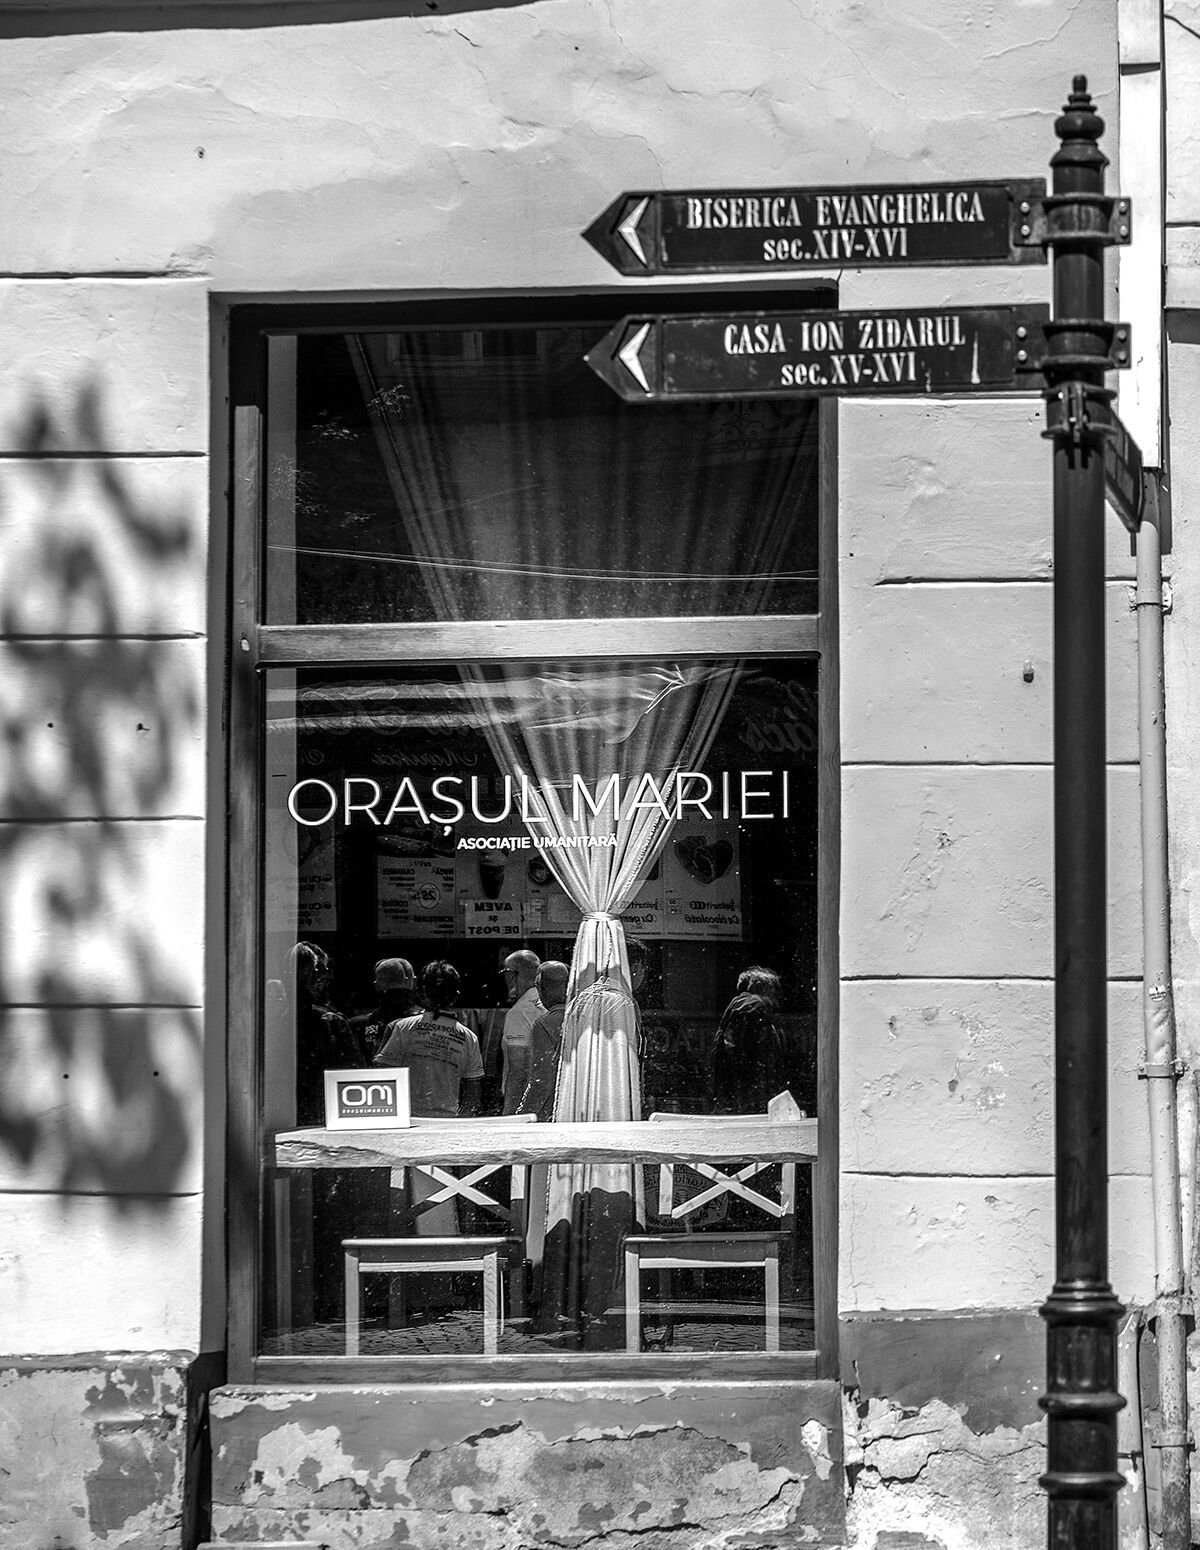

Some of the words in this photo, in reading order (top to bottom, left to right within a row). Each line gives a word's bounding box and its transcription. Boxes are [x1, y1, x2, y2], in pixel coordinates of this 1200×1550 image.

[686, 196, 803, 229] BISERICA
[815, 191, 985, 225] EVANGHELICA
[763, 227, 908, 261] sec.XIV-XVI
[723, 322, 787, 355] CASA
[801, 320, 845, 353] ION
[858, 315, 966, 349] ZIDARUL
[780, 351, 917, 386] sec.XV-XVI
[286, 774, 547, 837] ORAȘUL
[572, 770, 790, 822] MARIEI
[532, 832, 619, 850] UMANITARĂ
